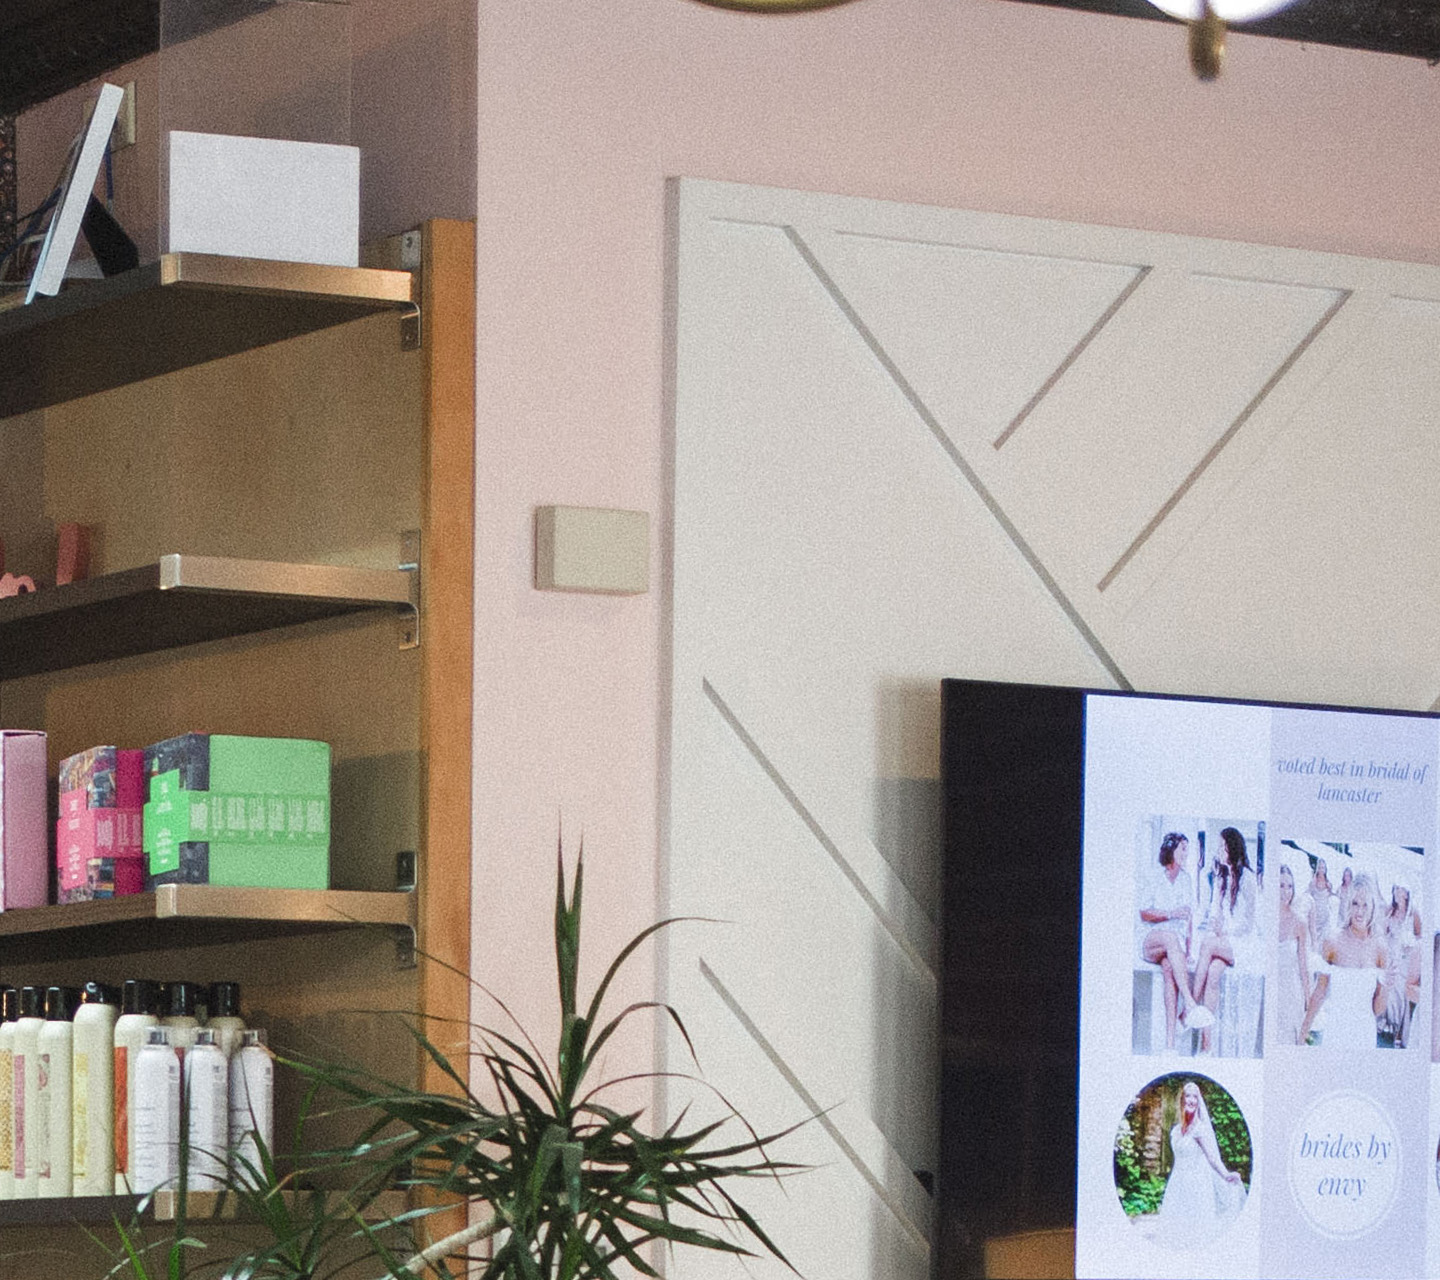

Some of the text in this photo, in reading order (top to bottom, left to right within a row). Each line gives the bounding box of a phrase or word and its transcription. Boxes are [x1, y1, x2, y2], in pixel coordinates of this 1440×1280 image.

[1277, 757, 1429, 785] voted best in bridal of
[1317, 783, 1382, 803] lancaster
[1301, 1132, 1391, 1165] brides by
[1318, 1177, 1367, 1202] envy
